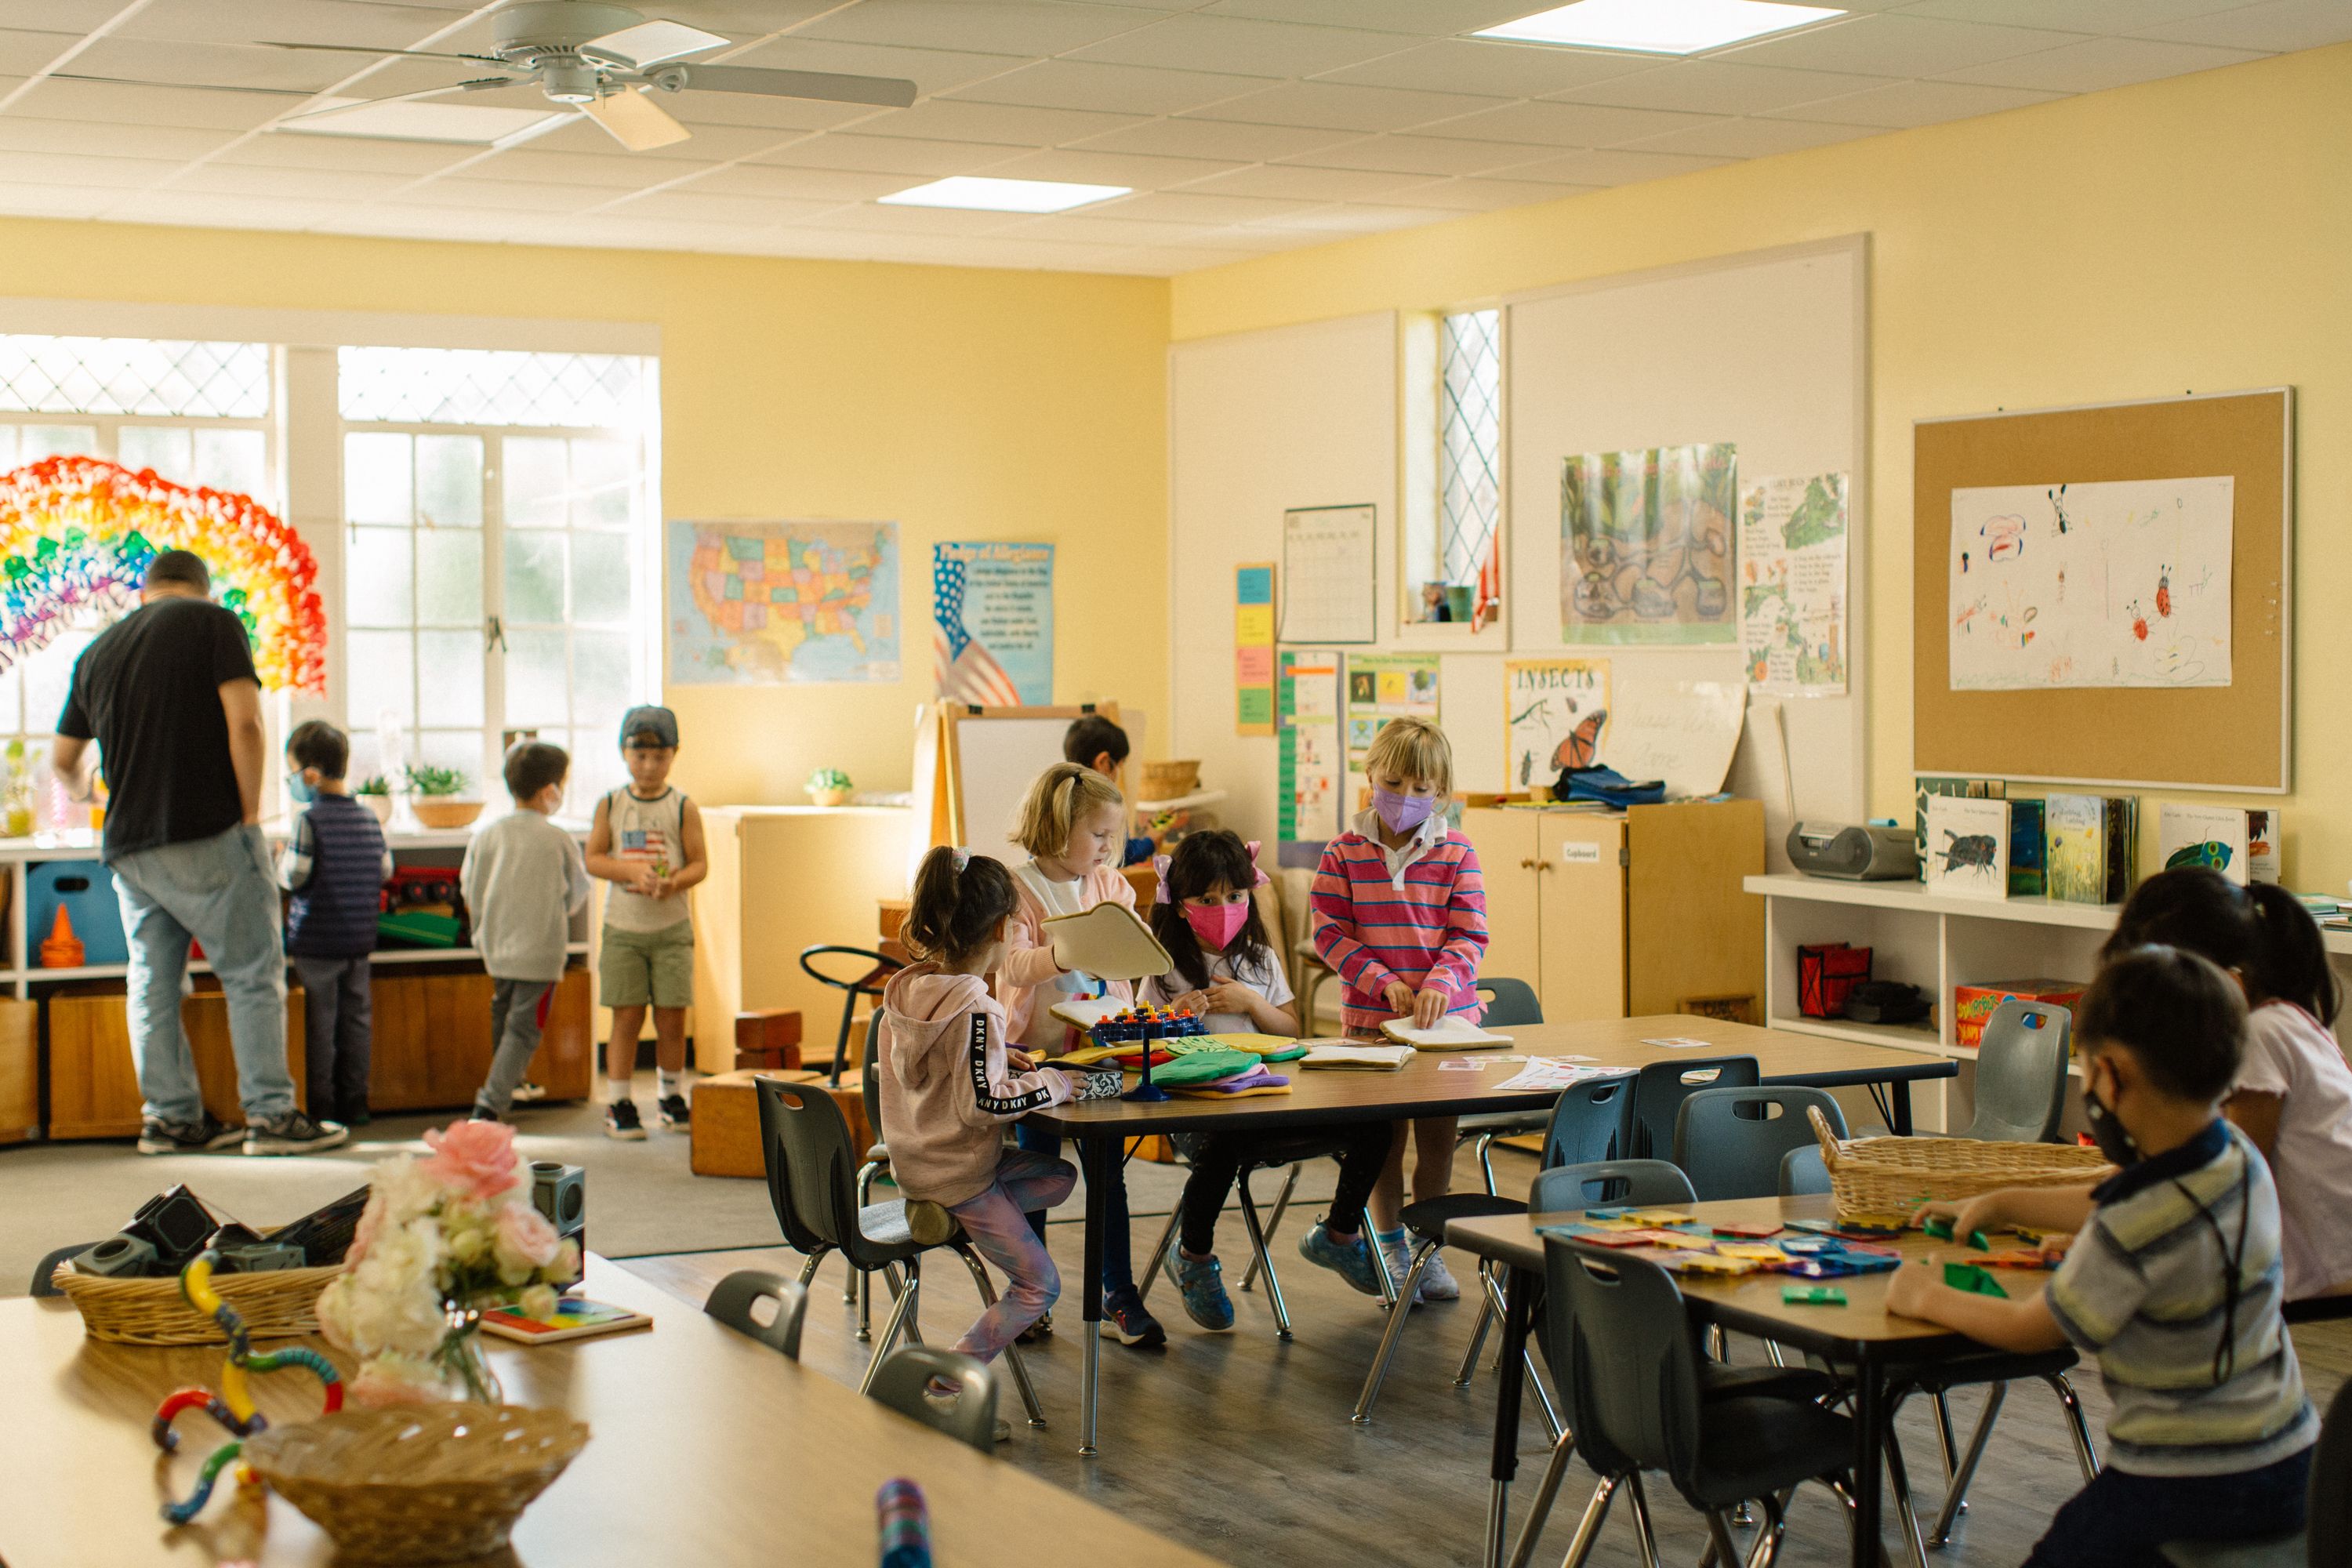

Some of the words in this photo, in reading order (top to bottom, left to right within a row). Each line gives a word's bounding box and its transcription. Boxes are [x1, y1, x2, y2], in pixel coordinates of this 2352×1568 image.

[1518, 666, 1594, 690] INSECTS
[1566, 848, 1596, 858] Cupboard
[975, 1019, 985, 1051] DKNY
[975, 1060, 987, 1089] DKNY
[1036, 1089, 1049, 1102] DK
